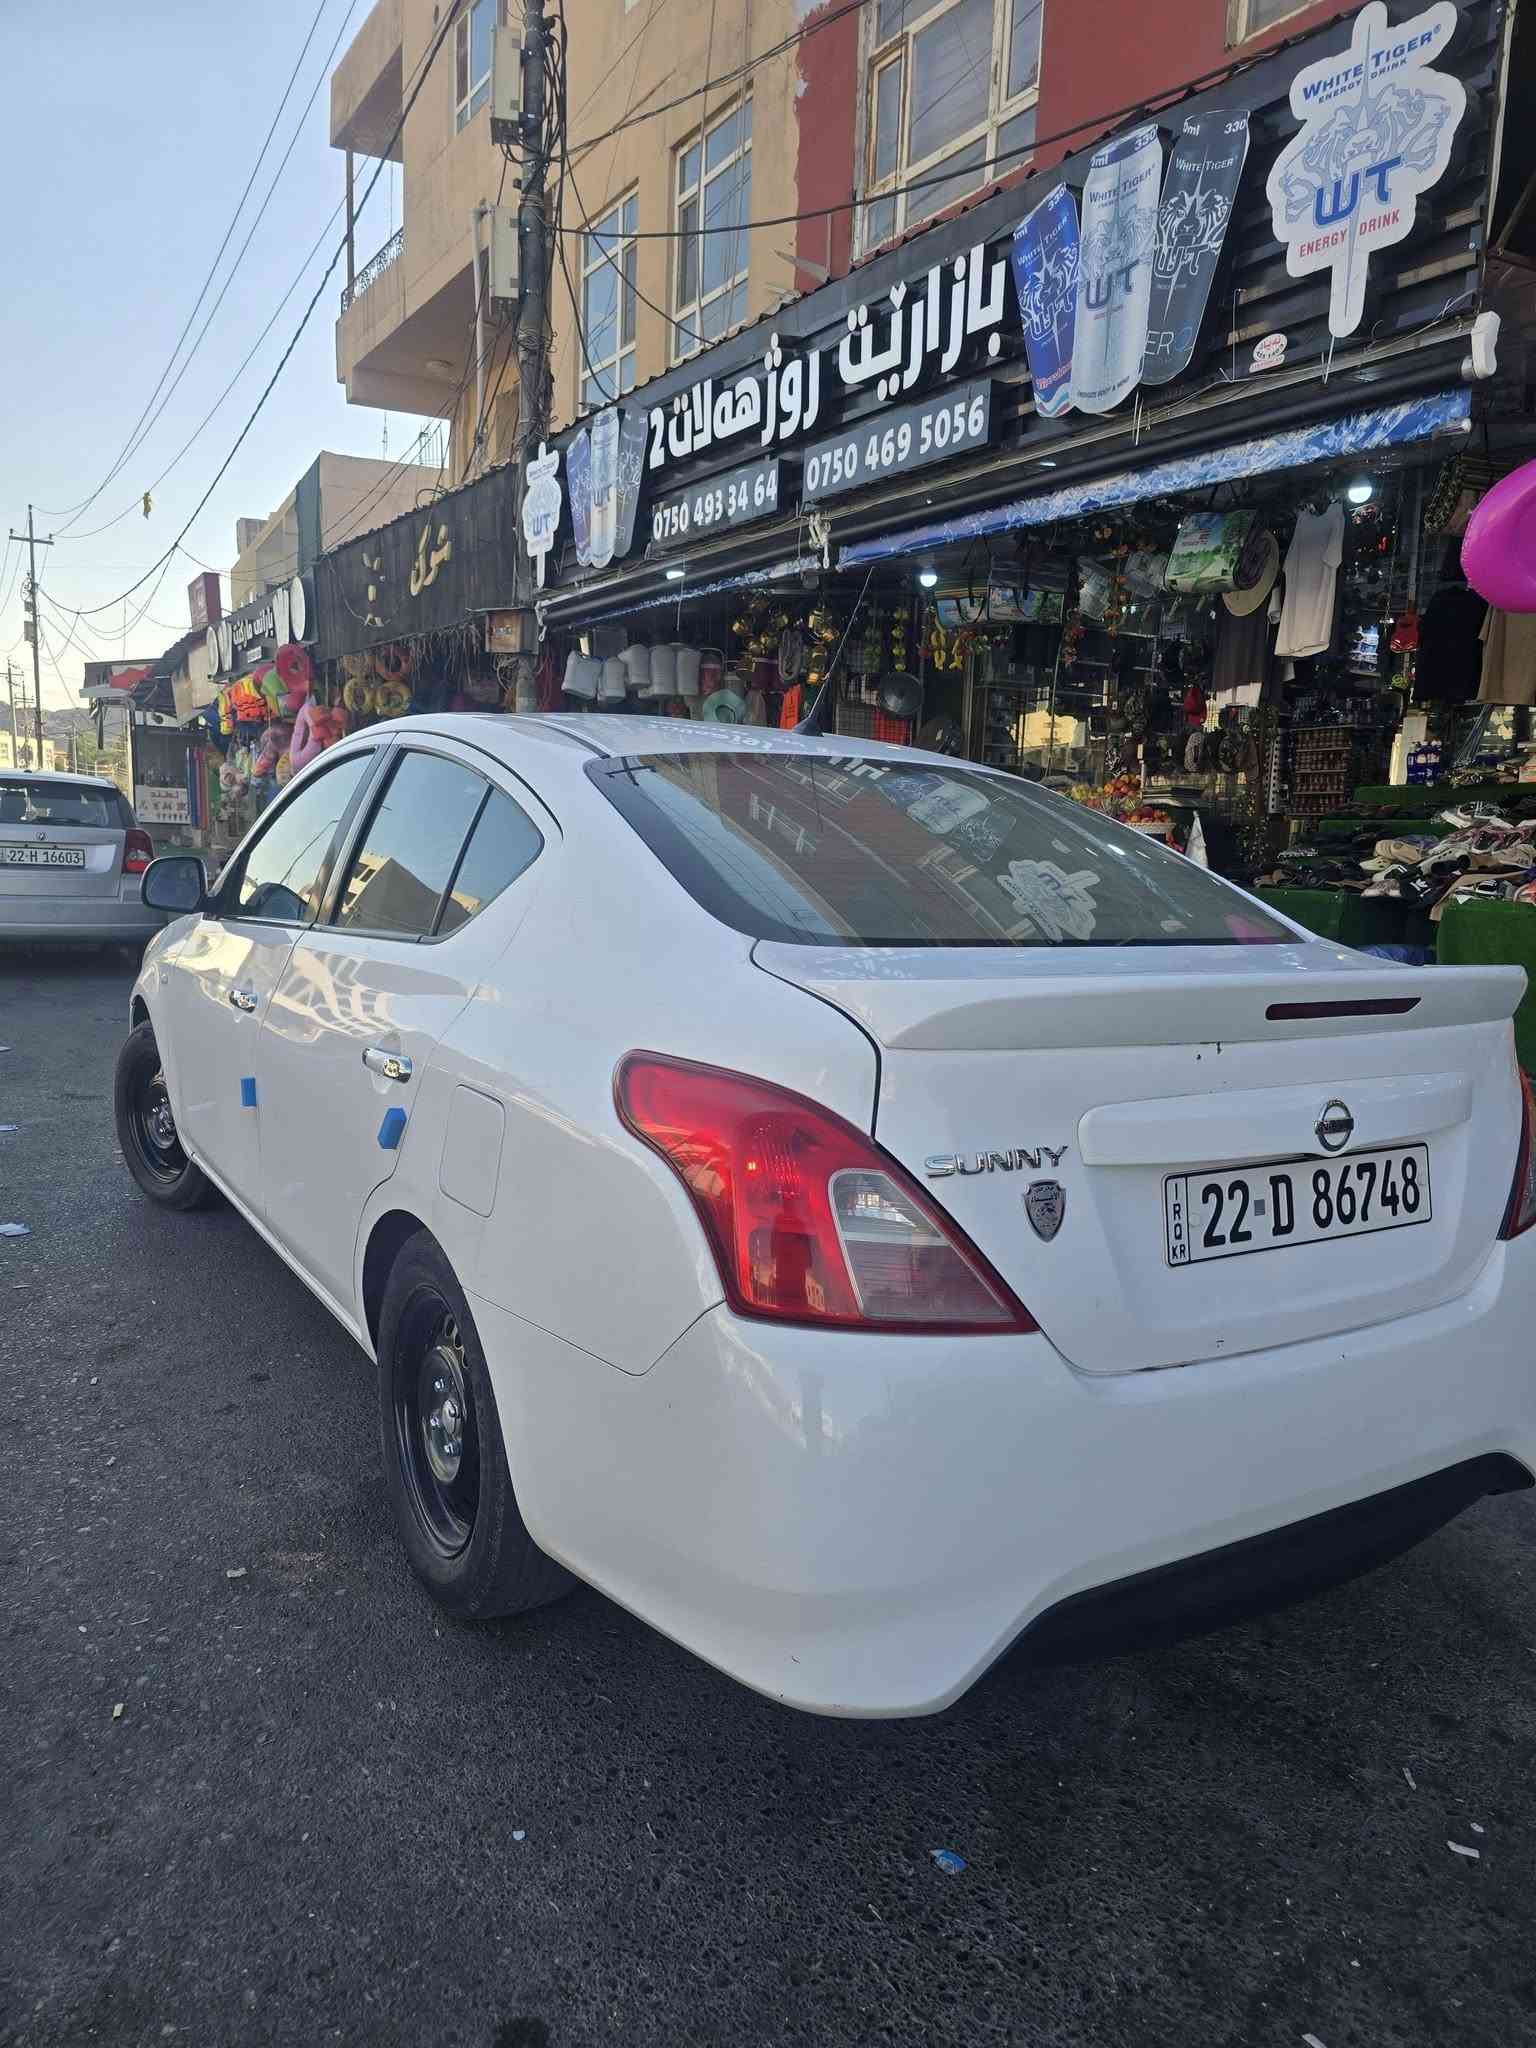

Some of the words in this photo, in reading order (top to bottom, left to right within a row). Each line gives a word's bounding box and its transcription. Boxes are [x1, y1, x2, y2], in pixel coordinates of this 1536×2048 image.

[1302, 63, 1364, 101] WHITE
[1318, 78, 1363, 104] ENERGY
[1370, 58, 1408, 80] DRINK
[1224, 119, 1246, 134] 330
[1176, 157, 1201, 172] WHITE
[1205, 158, 1234, 171] TIGER
[1089, 189, 1120, 203] WHITE
[1313, 154, 1404, 228] WT
[1299, 228, 1348, 258] ENERGY
[1359, 208, 1400, 236] DRINK
[649, 407, 665, 470] 2
[806, 442, 858, 491] 0750
[864, 423, 912, 471] 469
[919, 394, 985, 455] 5056
[653, 502, 689, 540] 0750
[693, 489, 723, 526] 493
[727, 480, 749, 517] 34
[754, 469, 778, 507] 64
[43, 851, 81, 864] 16603
[925, 1144, 1069, 1178] SUNNY
[1311, 1156, 1420, 1229] 86748
[1171, 1244, 1187, 1260] KR
